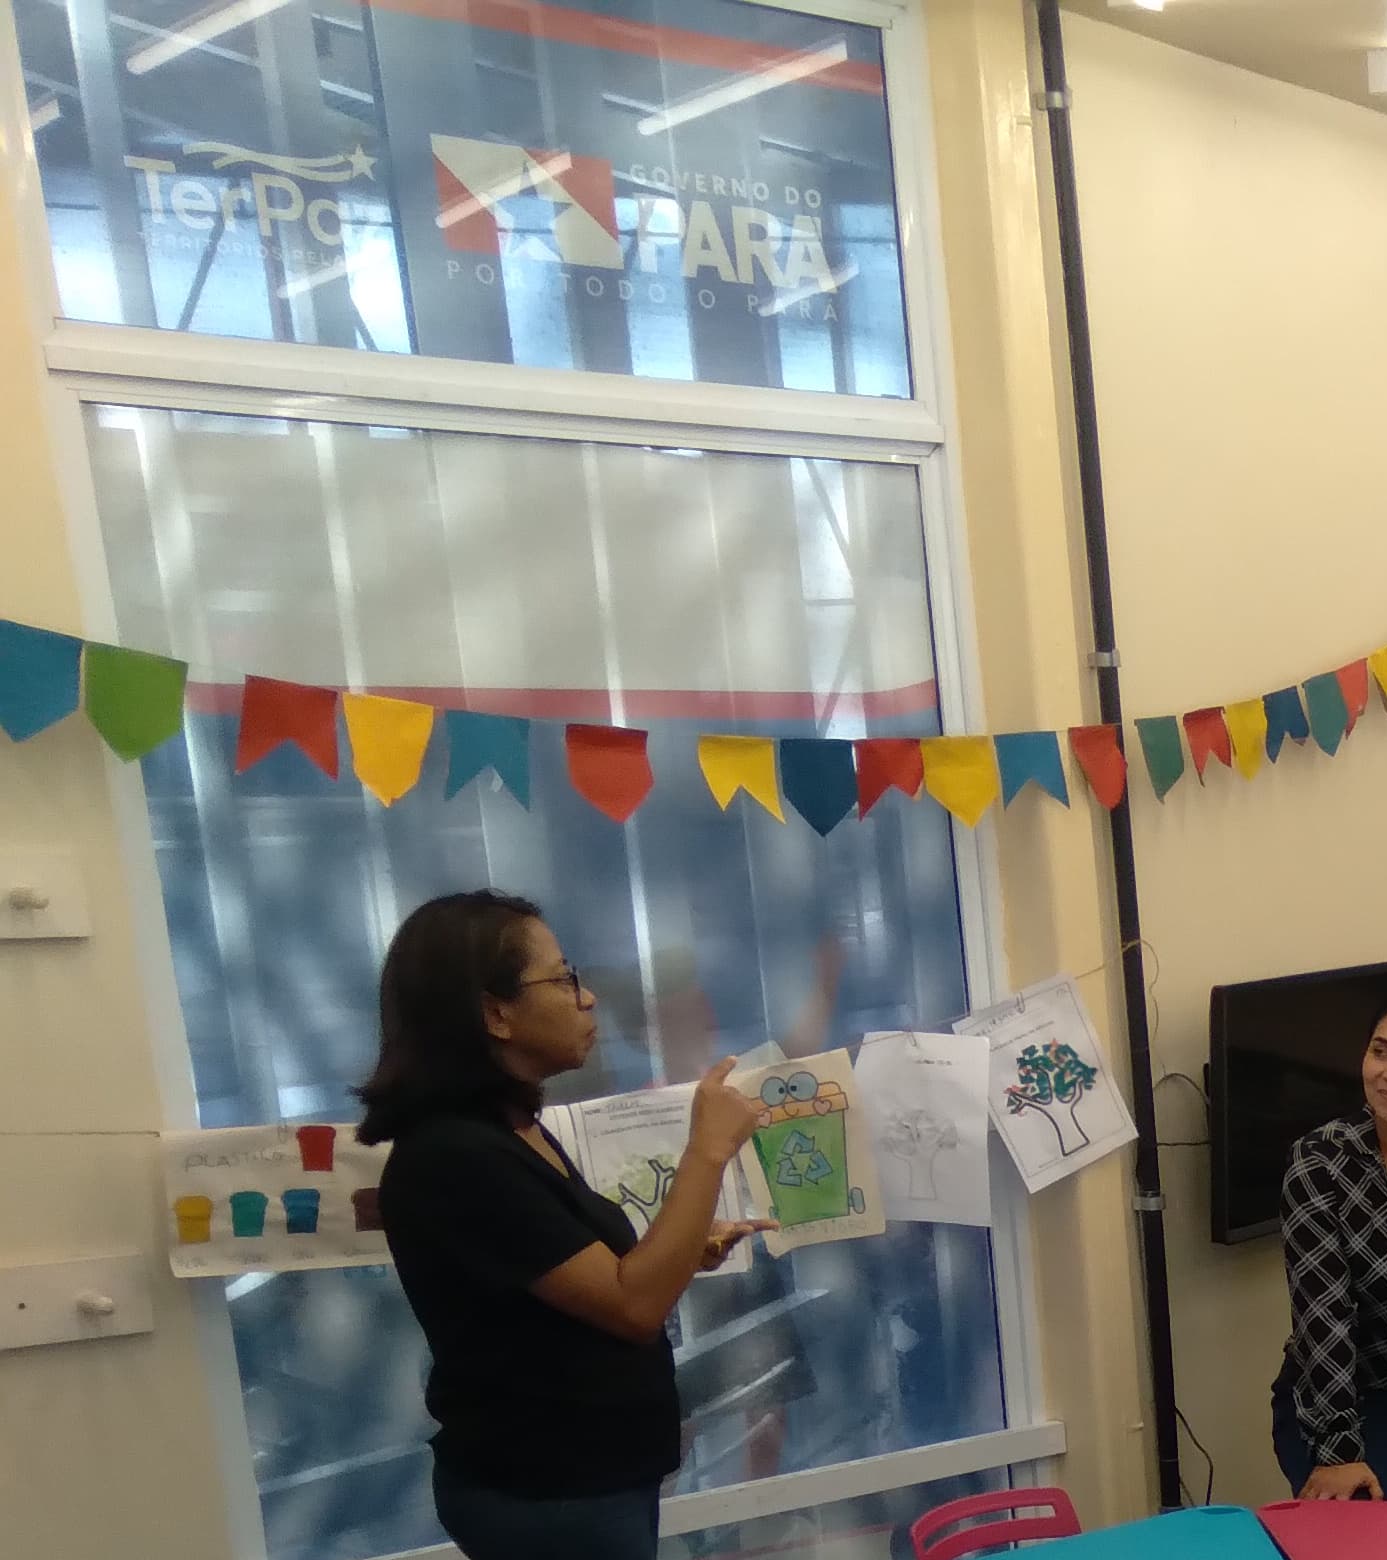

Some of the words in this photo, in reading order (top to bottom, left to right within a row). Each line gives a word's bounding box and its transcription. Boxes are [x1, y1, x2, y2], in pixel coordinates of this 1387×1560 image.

[629, 164, 770, 202] GOVERNO
[784, 185, 822, 209] DO
[558, 272, 667, 304] TODO
[698, 289, 716, 309] O
